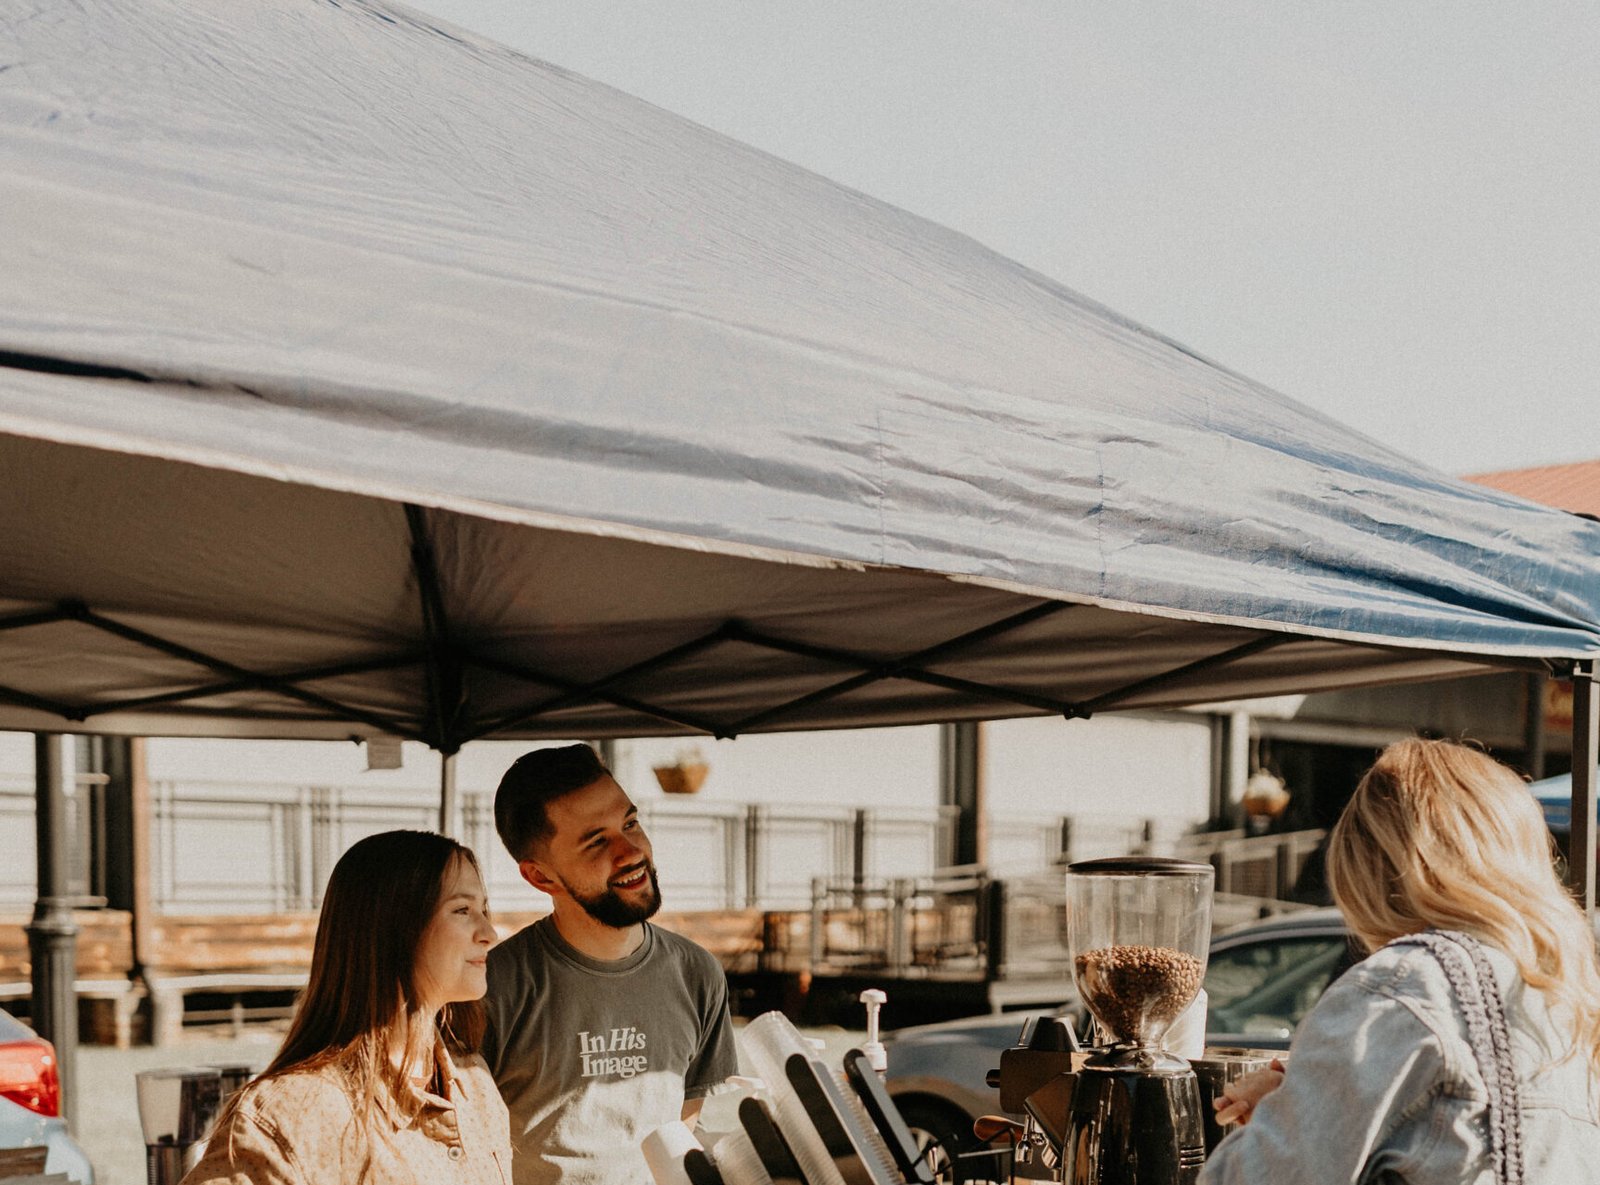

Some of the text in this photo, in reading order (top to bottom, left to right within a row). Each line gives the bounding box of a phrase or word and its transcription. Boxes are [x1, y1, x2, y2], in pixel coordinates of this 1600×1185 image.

[578, 1027, 646, 1054] In His
[580, 1055, 648, 1078] Image
